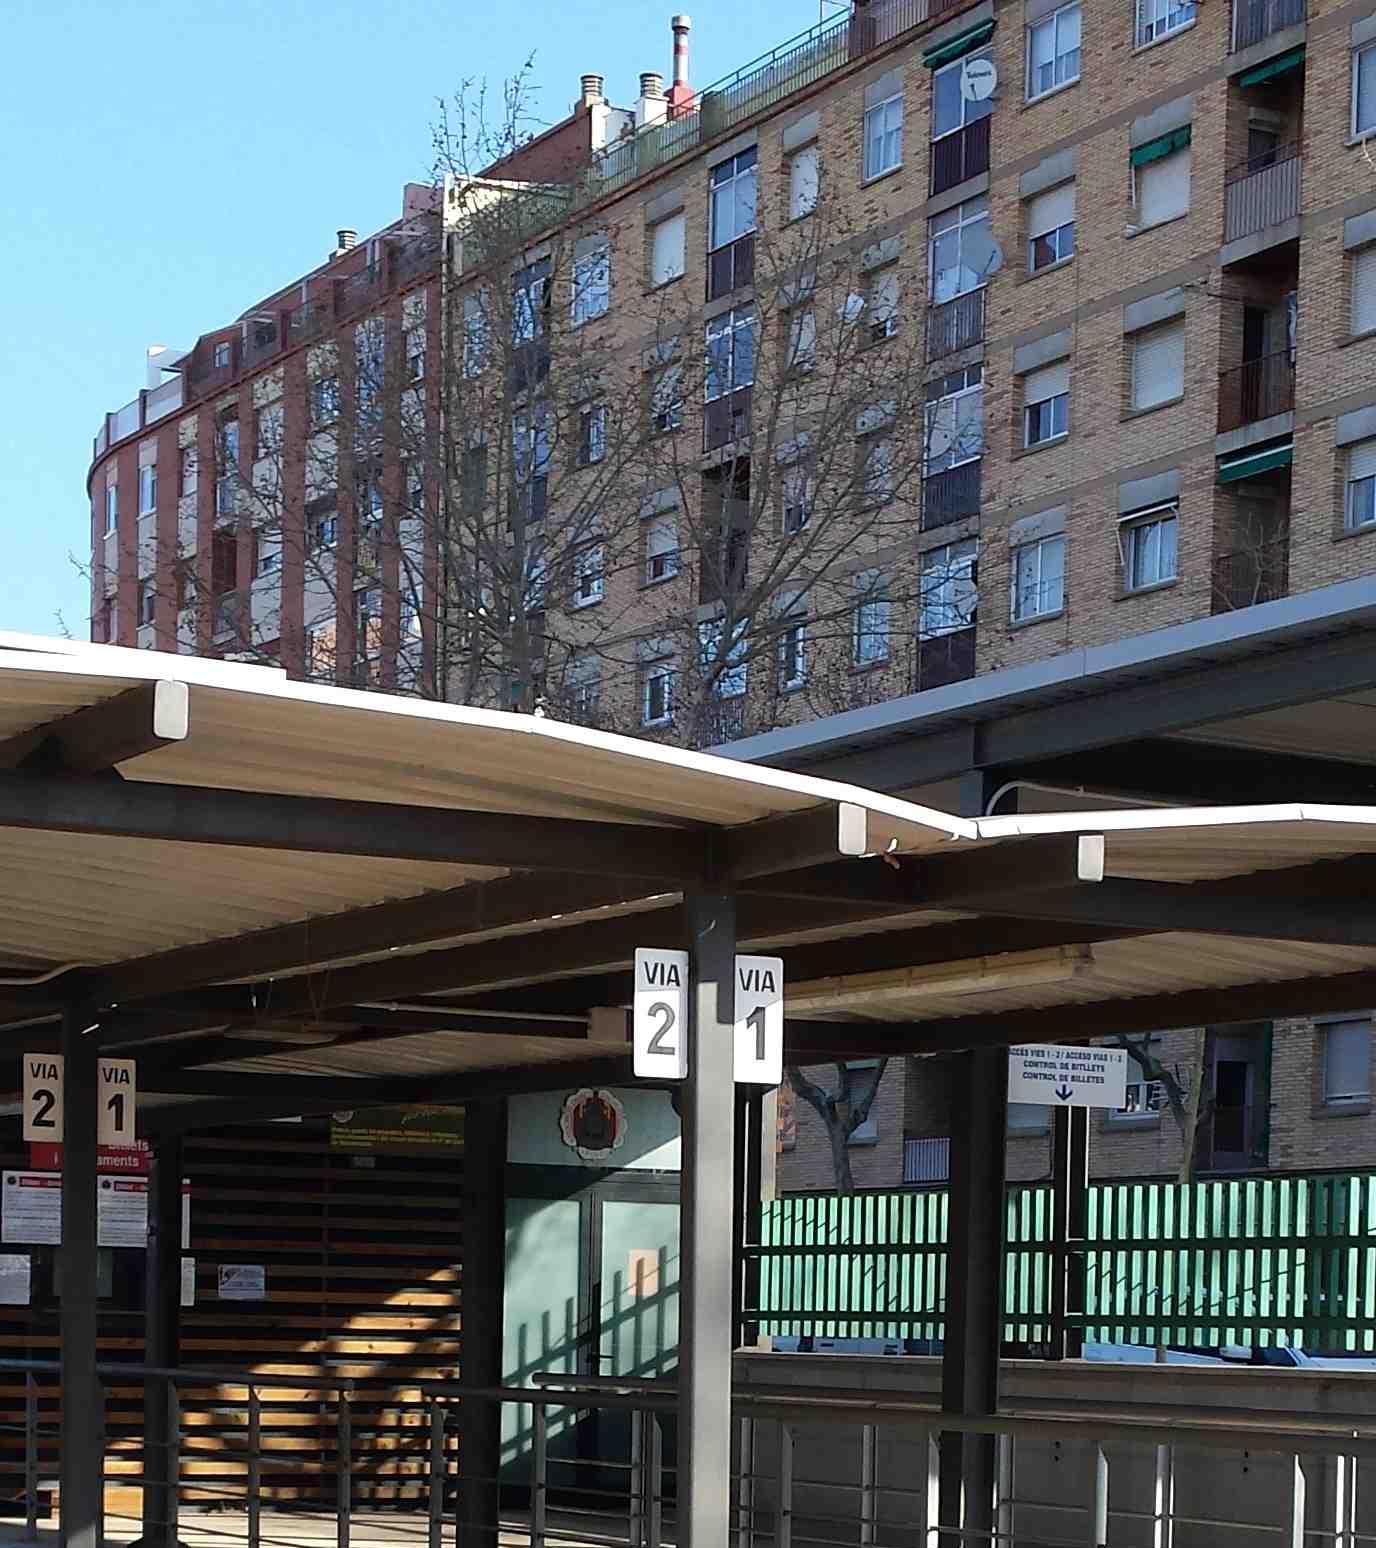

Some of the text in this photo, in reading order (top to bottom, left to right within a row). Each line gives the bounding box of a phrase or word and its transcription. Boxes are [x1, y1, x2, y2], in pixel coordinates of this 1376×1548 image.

[644, 961, 680, 987] VIA
[739, 968, 776, 993] VIA
[647, 1001, 675, 1056] 2
[745, 1006, 766, 1060] 1
[30, 1062, 59, 1081] VIA
[102, 1067, 130, 1084] VIA
[1023, 1060, 1056, 1070] CONTROL
[1060, 1062, 1069, 1070] DE
[1023, 1071, 1105, 1084] CONTROL DE BILLETES
[31, 1089, 55, 1127] 2
[107, 1093, 125, 1131] 1
